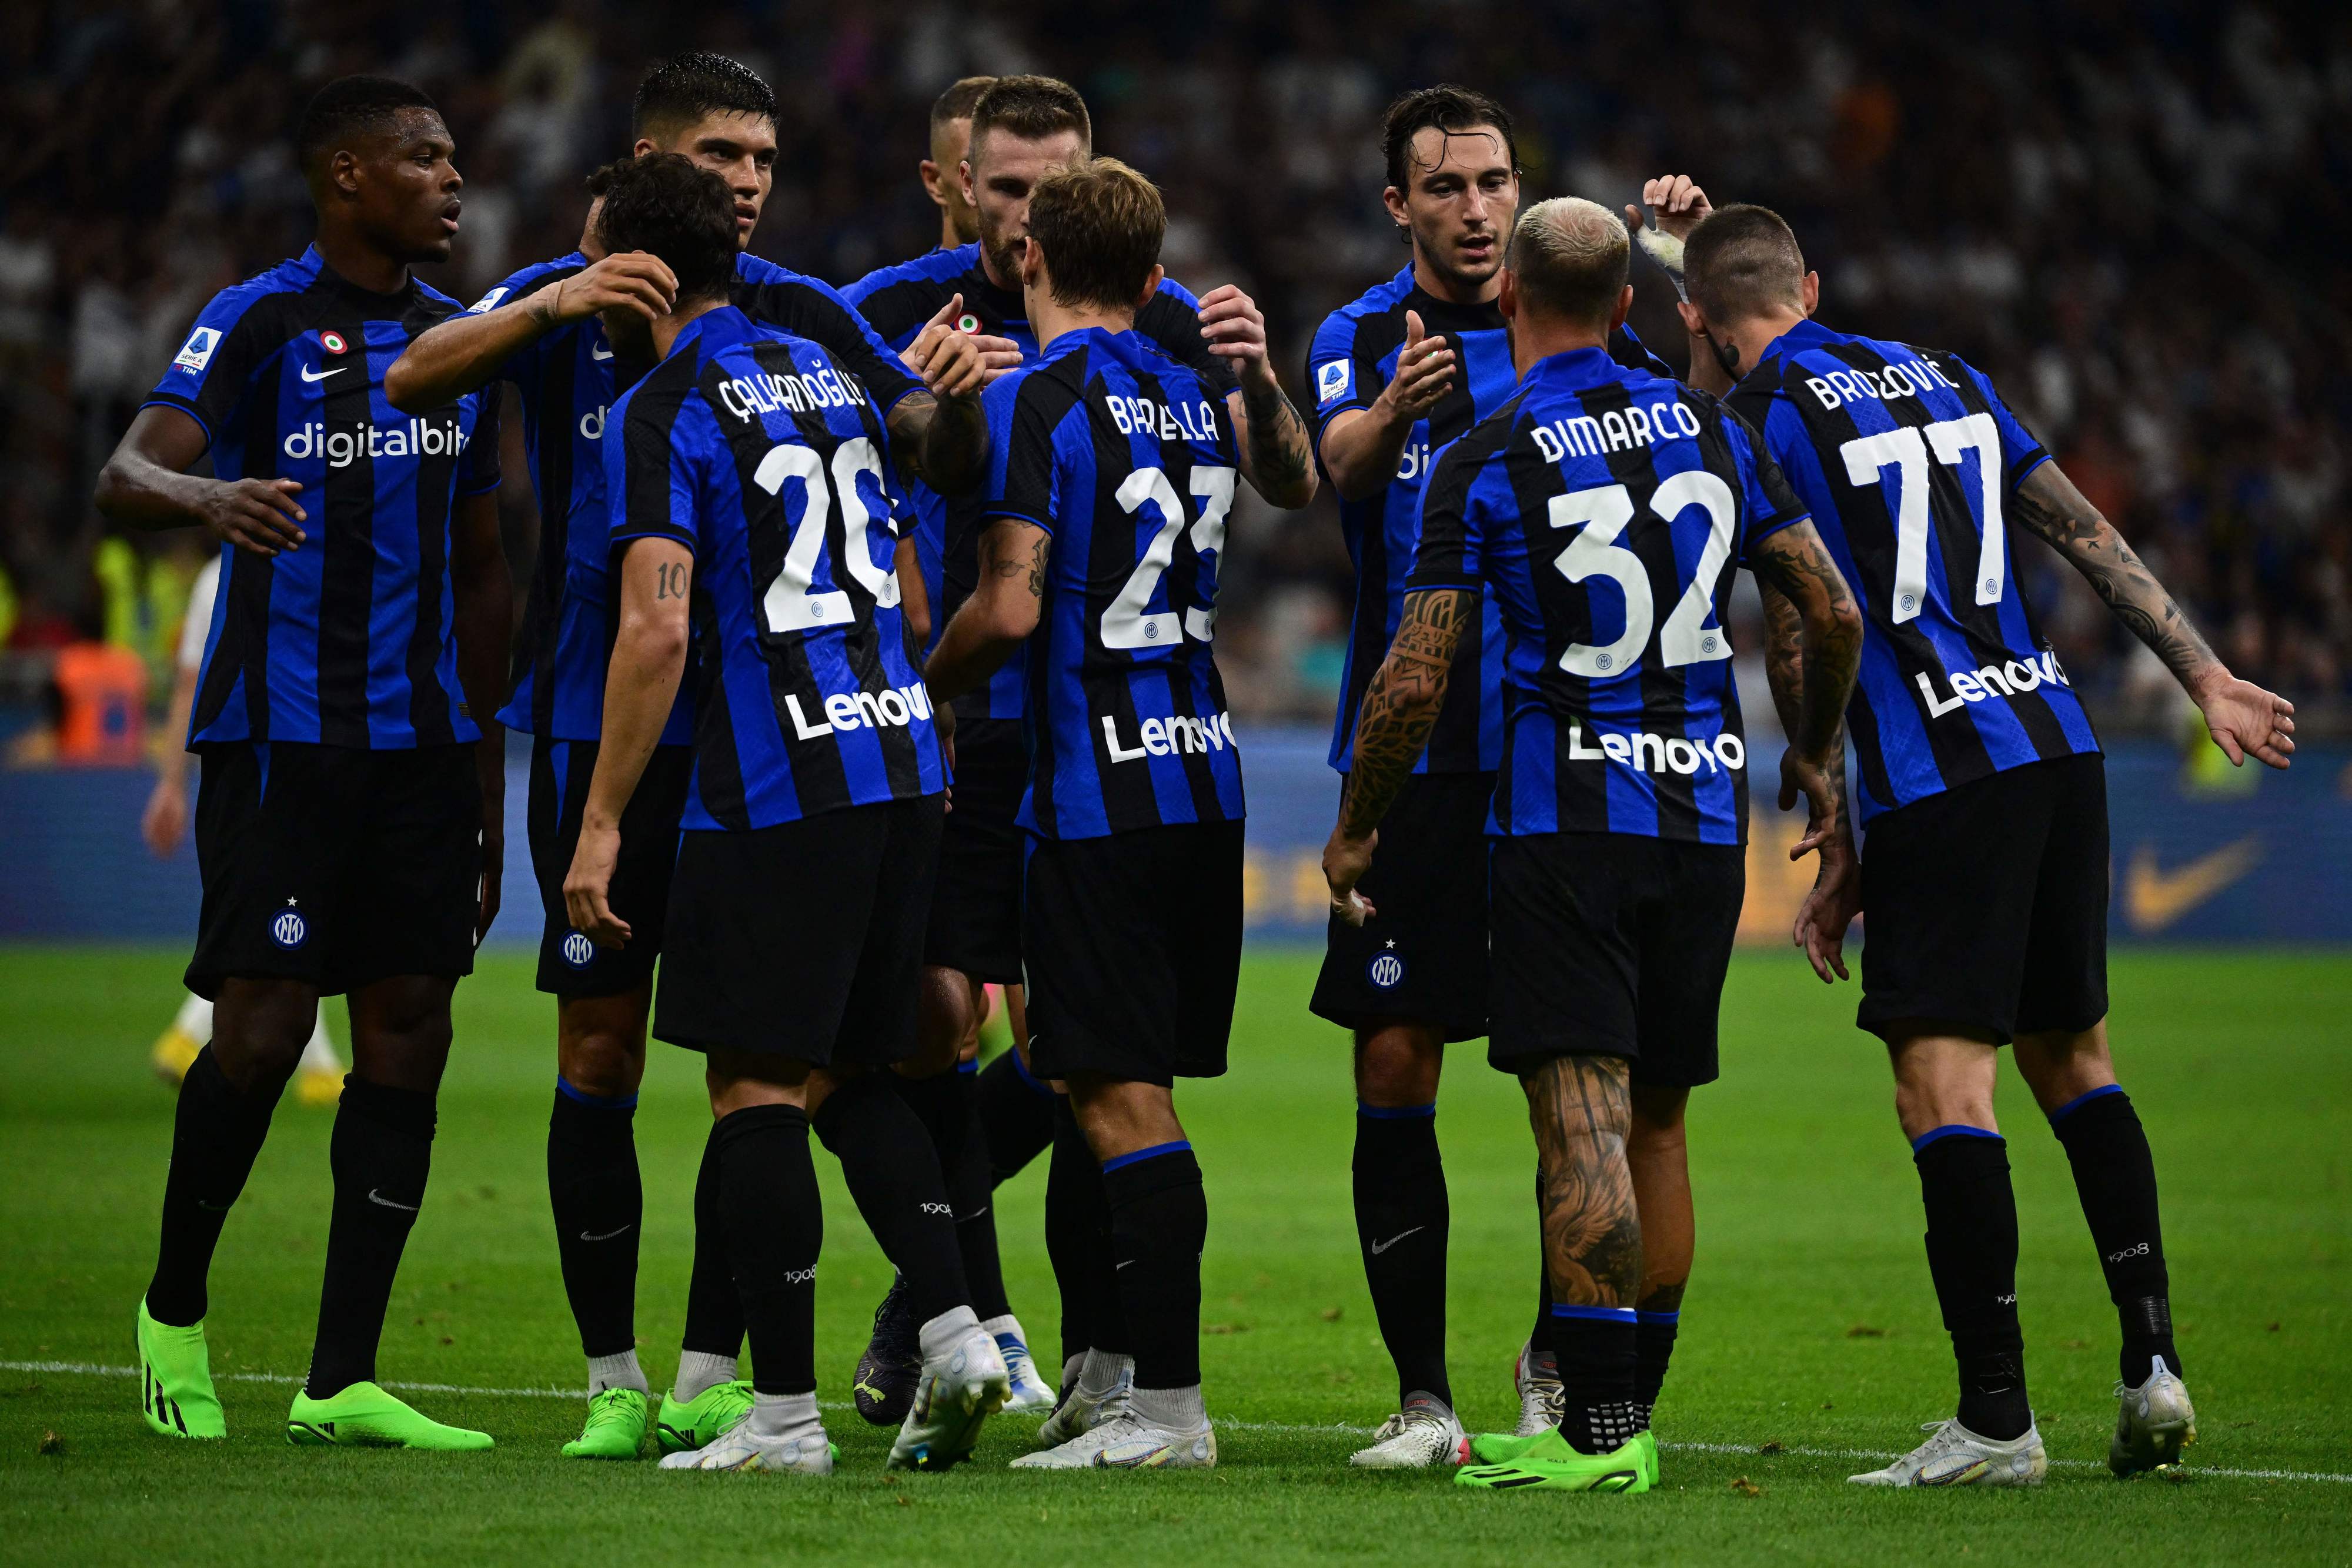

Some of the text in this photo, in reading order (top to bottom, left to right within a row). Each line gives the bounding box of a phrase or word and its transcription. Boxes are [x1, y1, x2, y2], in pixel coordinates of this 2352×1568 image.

[182, 366, 197, 376] TIM
[1324, 384, 1339, 395] SERIE
[1332, 389, 1345, 400] TIM
[1530, 402, 1700, 464] DIMARCO
[1839, 412, 2004, 624] 77
[658, 563, 687, 599] 10
[1548, 470, 1735, 677] 32
[784, 681, 934, 741] Lenov
[2107, 1242, 2150, 1263] 1908
[1995, 1292, 2016, 1305] 190
